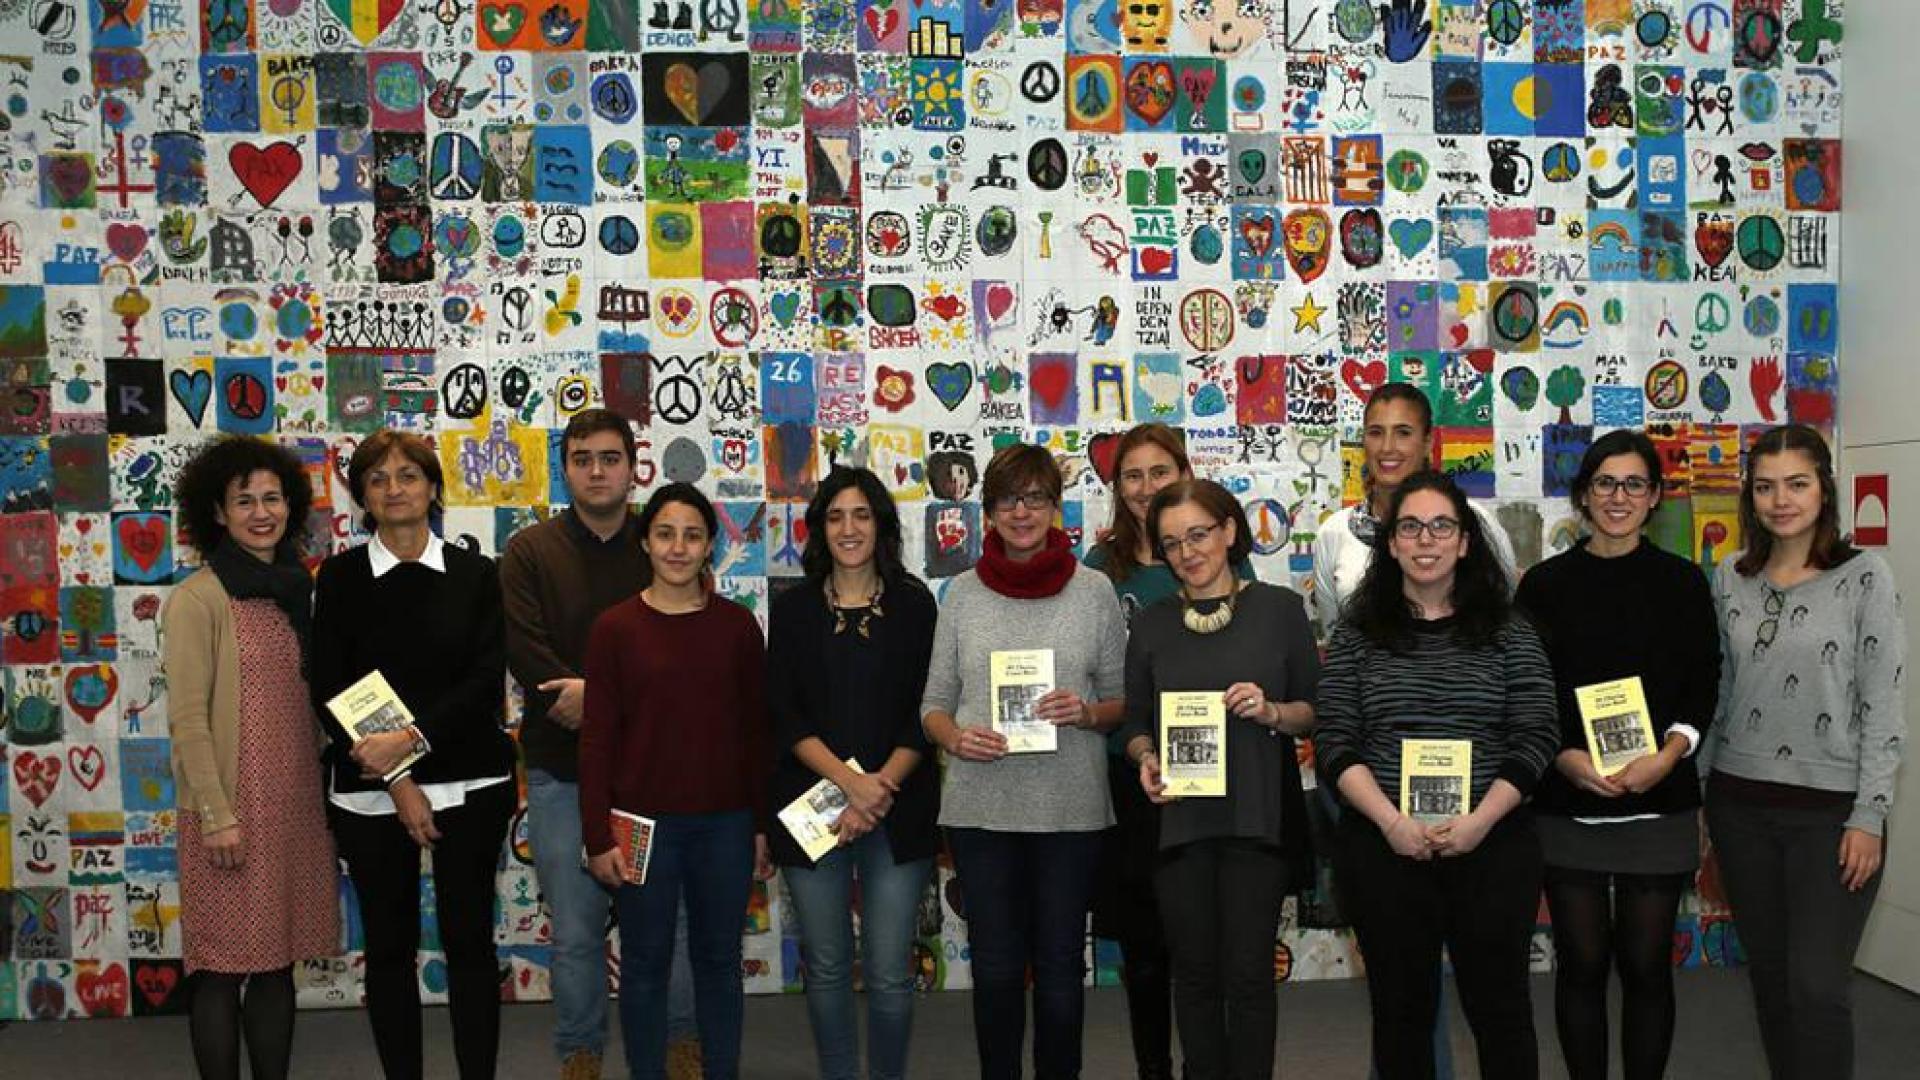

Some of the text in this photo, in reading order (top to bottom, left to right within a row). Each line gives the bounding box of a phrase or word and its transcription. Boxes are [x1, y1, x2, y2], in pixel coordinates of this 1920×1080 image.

[1587, 46, 1627, 61] PAZ
[1135, 217, 1178, 237] PAZ
[55, 244, 101, 264] PAZ
[1143, 285, 1162, 301] IN
[1136, 301, 1173, 316] DEPEN
[1139, 316, 1170, 330] DEN
[769, 356, 802, 383] 26
[119, 384, 150, 415] R
[929, 431, 976, 452] PAZ
[1035, 429, 1081, 453] PAZ
[131, 832, 162, 847] LOVE
[71, 848, 115, 869] PAZ
